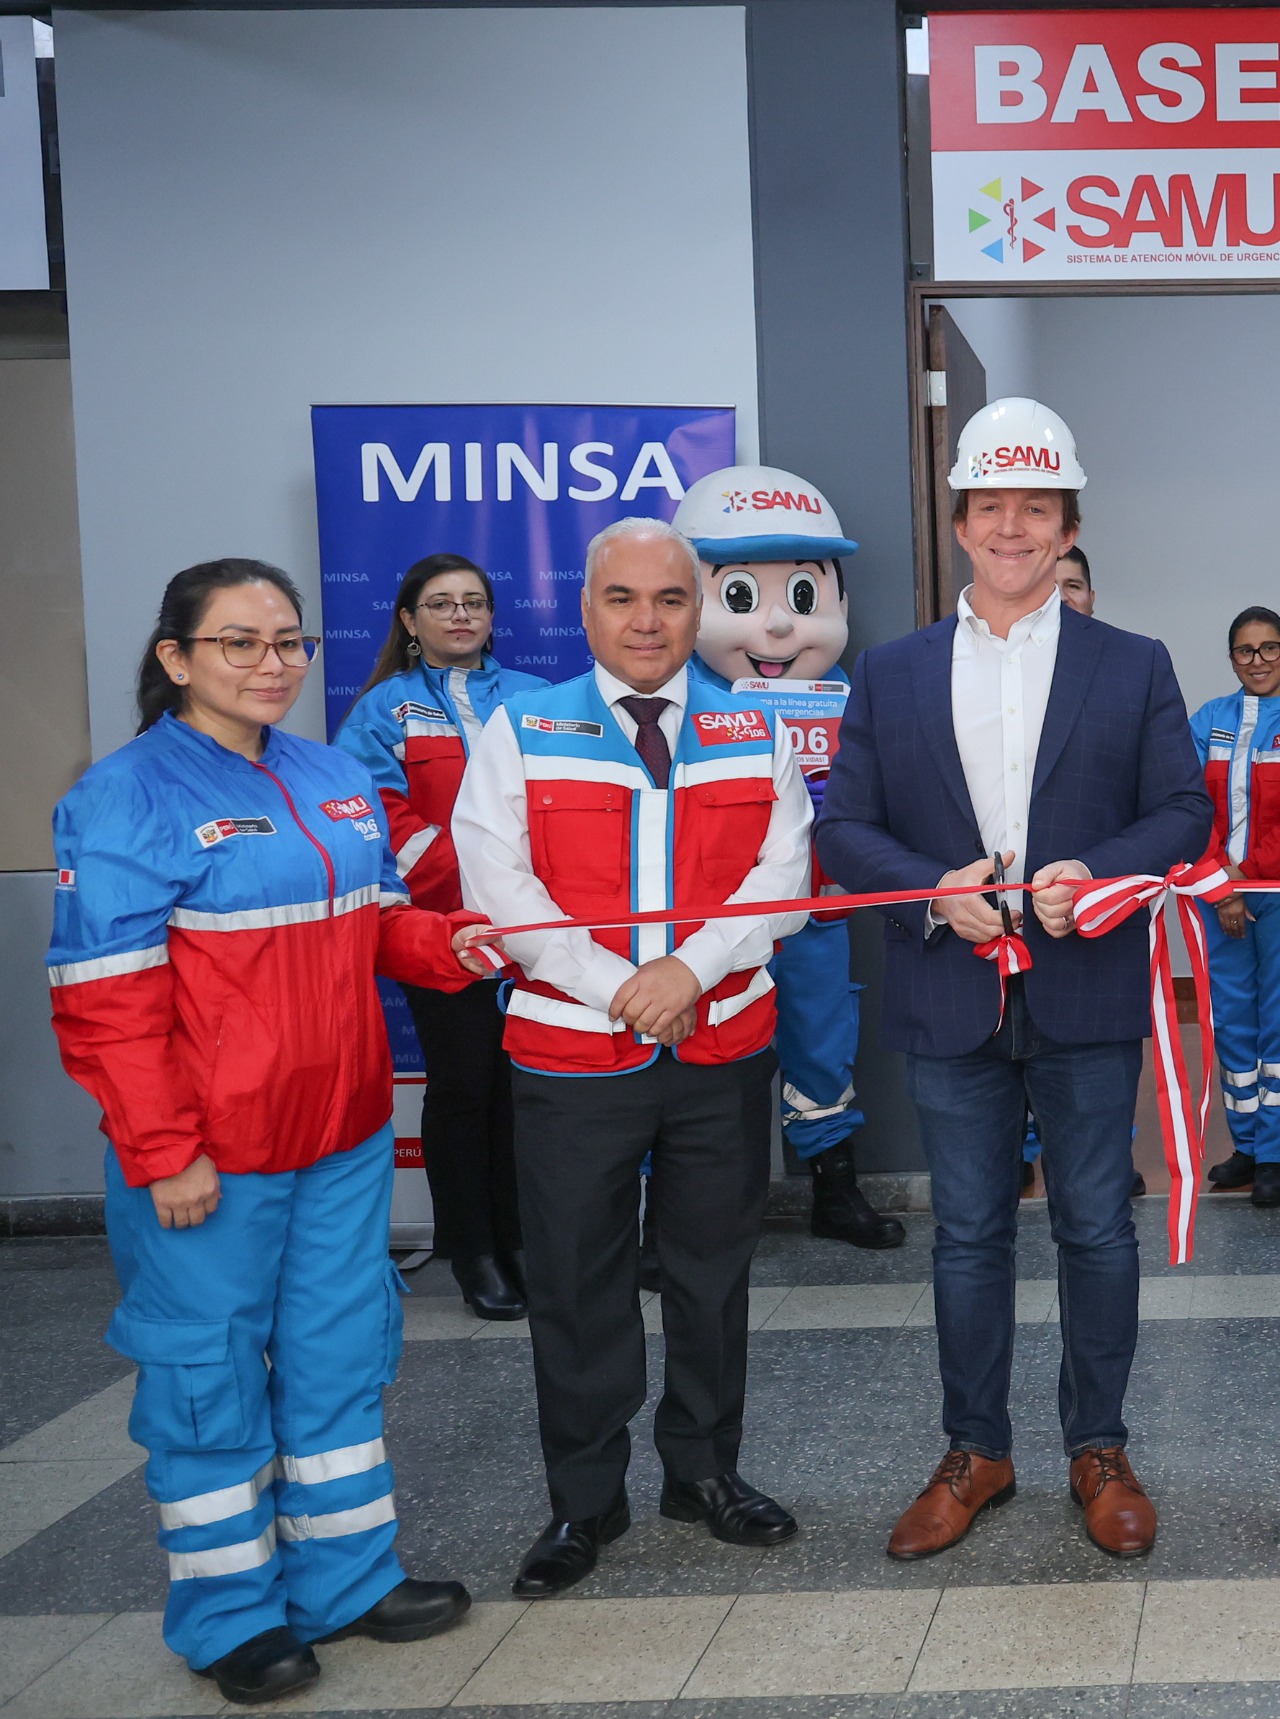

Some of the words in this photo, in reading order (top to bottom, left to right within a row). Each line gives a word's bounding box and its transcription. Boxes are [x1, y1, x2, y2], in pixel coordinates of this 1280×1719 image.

[1067, 255, 1112, 264] SISTEMA
[1114, 254, 1128, 263] DE
[1130, 252, 1183, 263] ATENCIÓN
[1185, 252, 1217, 262] MÓVIL
[1220, 253, 1233, 262] DE
[994, 446, 1060, 471] SAMU
[361, 442, 685, 503] MINSA
[751, 490, 822, 515] SAMU
[324, 573, 369, 582] MINSA
[539, 571, 584, 580] MINSA
[514, 599, 558, 609] SAMU
[326, 629, 371, 639] MINSA
[539, 627, 585, 636] MINSA
[514, 655, 558, 665] SAMU
[750, 681, 769, 690] SAMU
[788, 698, 806, 707] línea
[808, 699, 838, 708] gratuita
[699, 712, 758, 730] SAMU
[750, 728, 766, 738] 106
[788, 726, 829, 754] 06
